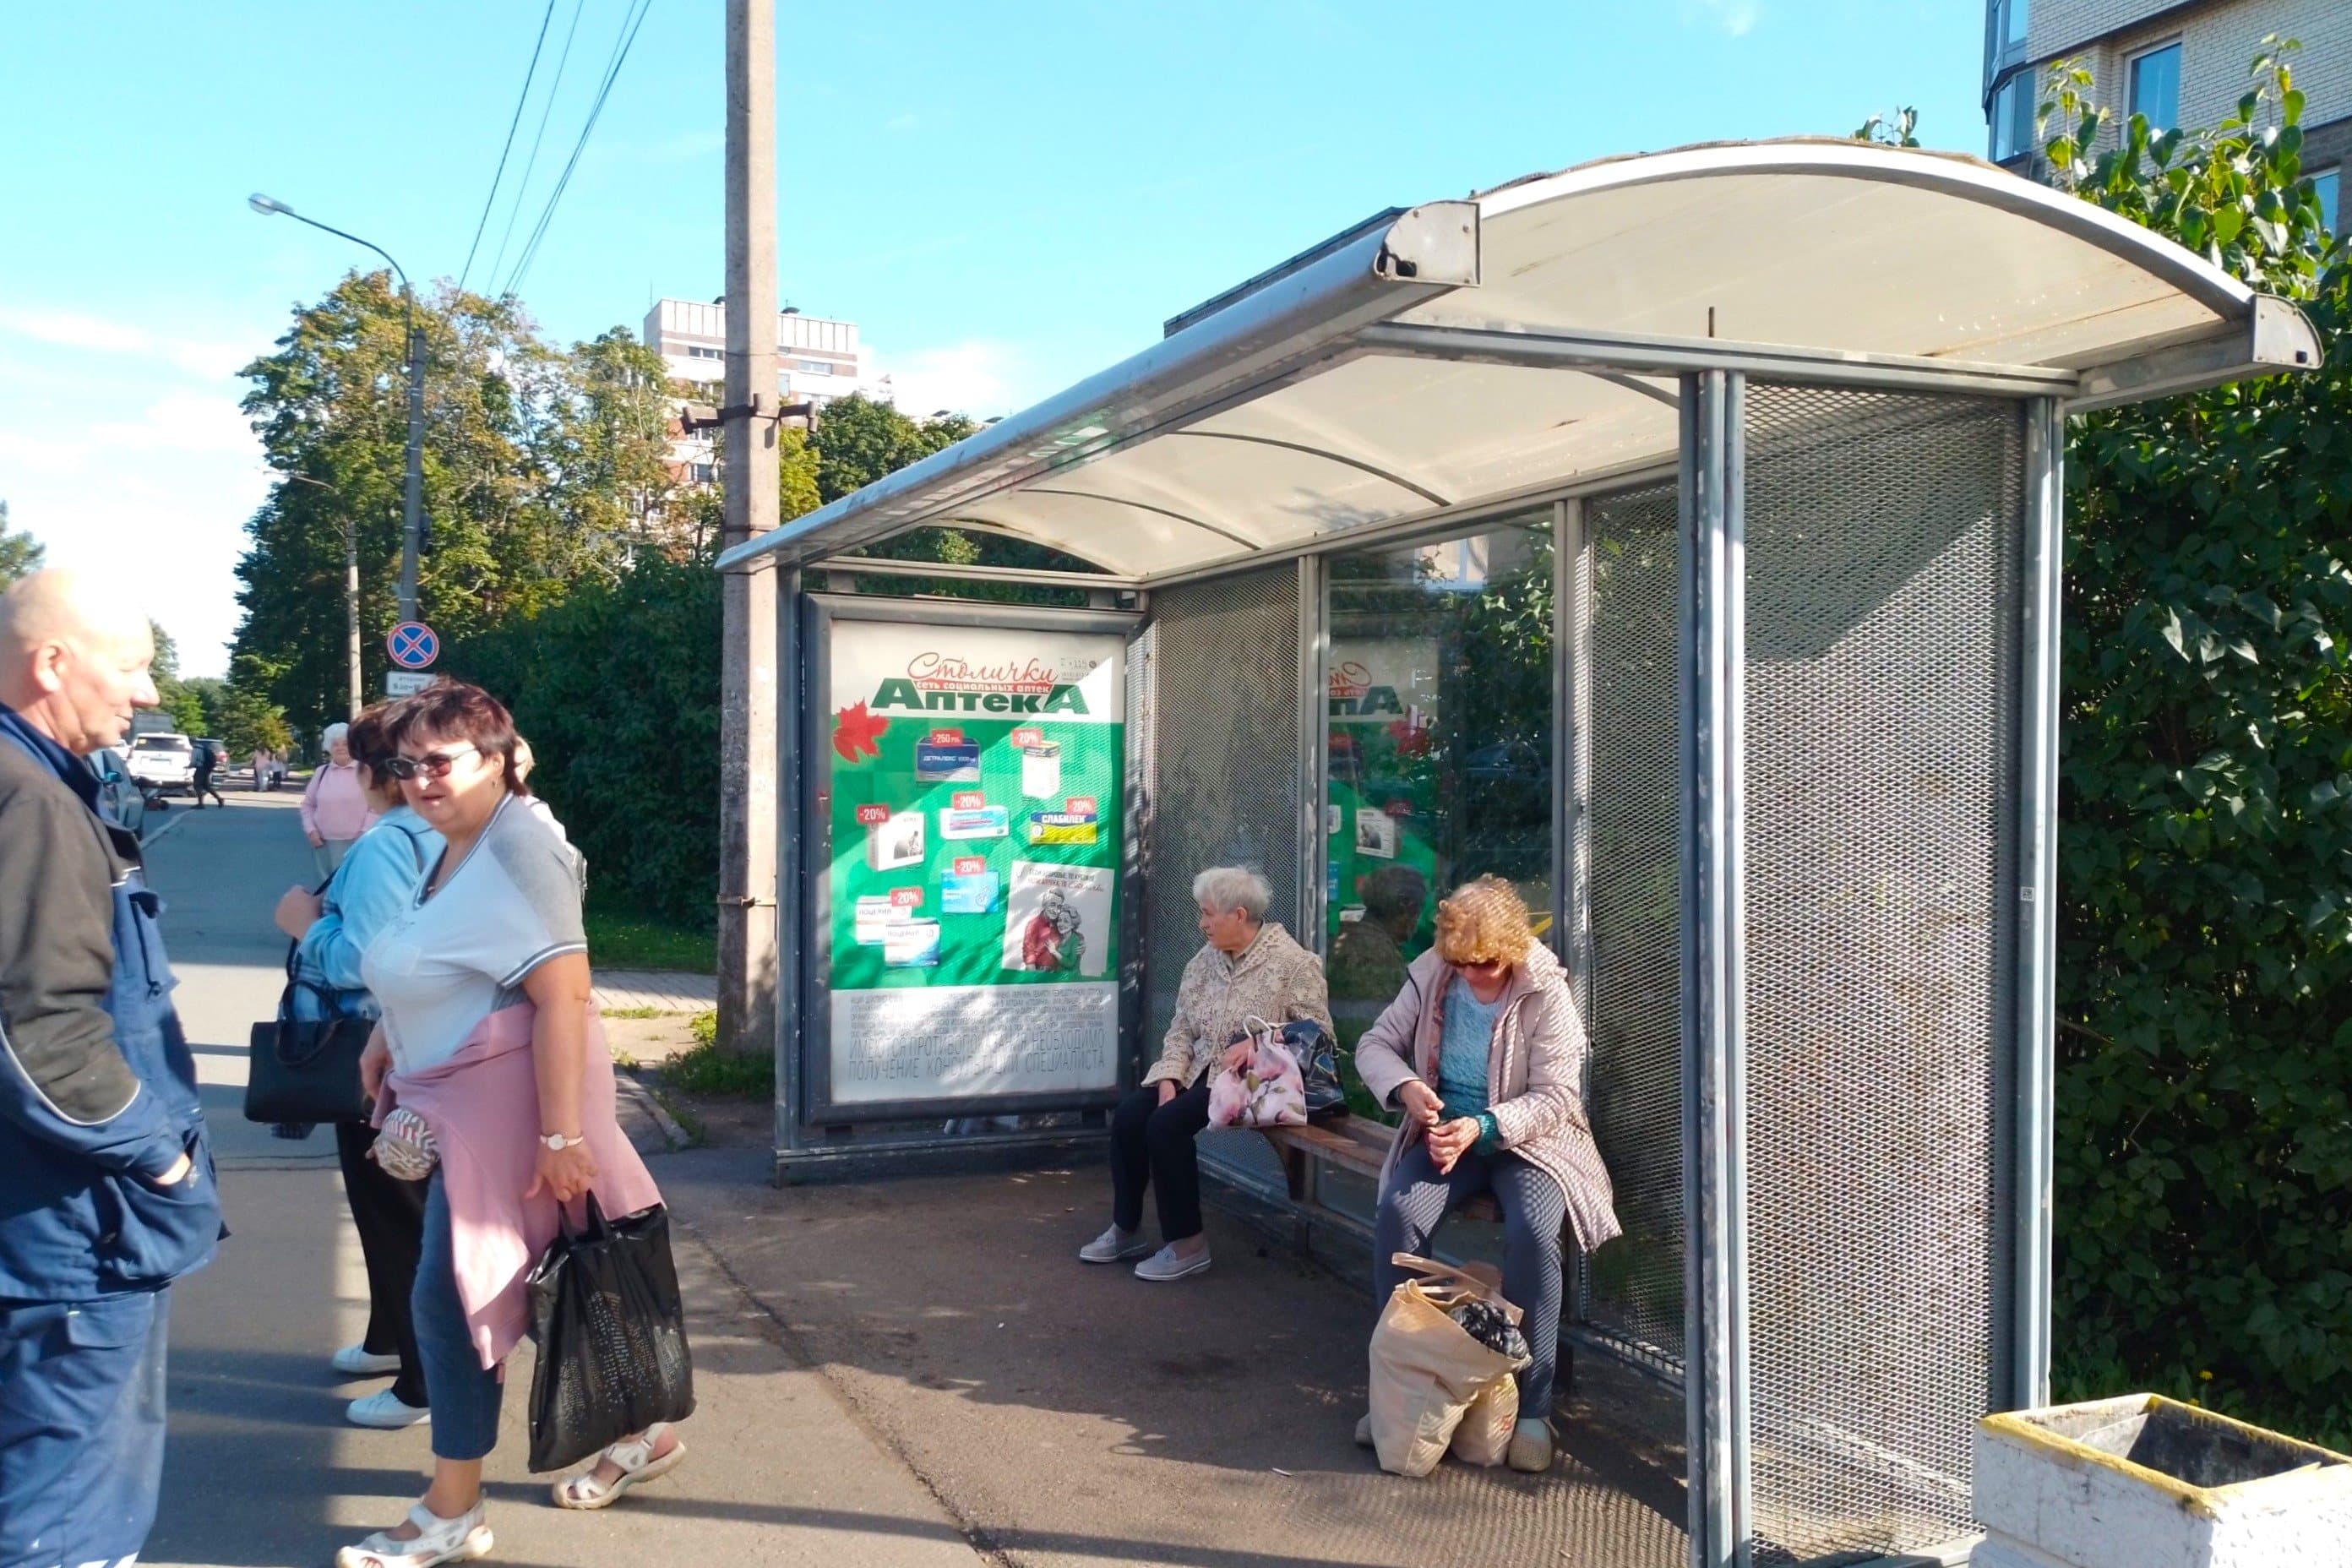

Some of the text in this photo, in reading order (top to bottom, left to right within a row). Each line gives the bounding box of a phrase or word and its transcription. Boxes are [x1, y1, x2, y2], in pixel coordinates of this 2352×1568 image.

[907, 651, 1058, 683] Столички
[917, 681, 1049, 694] сеть социальных аптек
[934, 733, 950, 743] -250
[1015, 732, 1039, 743] -20%
[956, 795, 981, 807] -20%
[1069, 800, 1091, 813] -20%
[859, 808, 885, 819] -20%
[956, 860, 981, 871] -20%
[893, 891, 919, 904] -20%
[908, 1032, 1026, 1058] ПРОТИВОПОИЯ
[1032, 1027, 1105, 1051] НЕОБХОДИМО
[848, 1057, 920, 1081] ПОЛУЧЕНИЕ
[1026, 1050, 1105, 1073] СПЕЦИАЛИСТА
